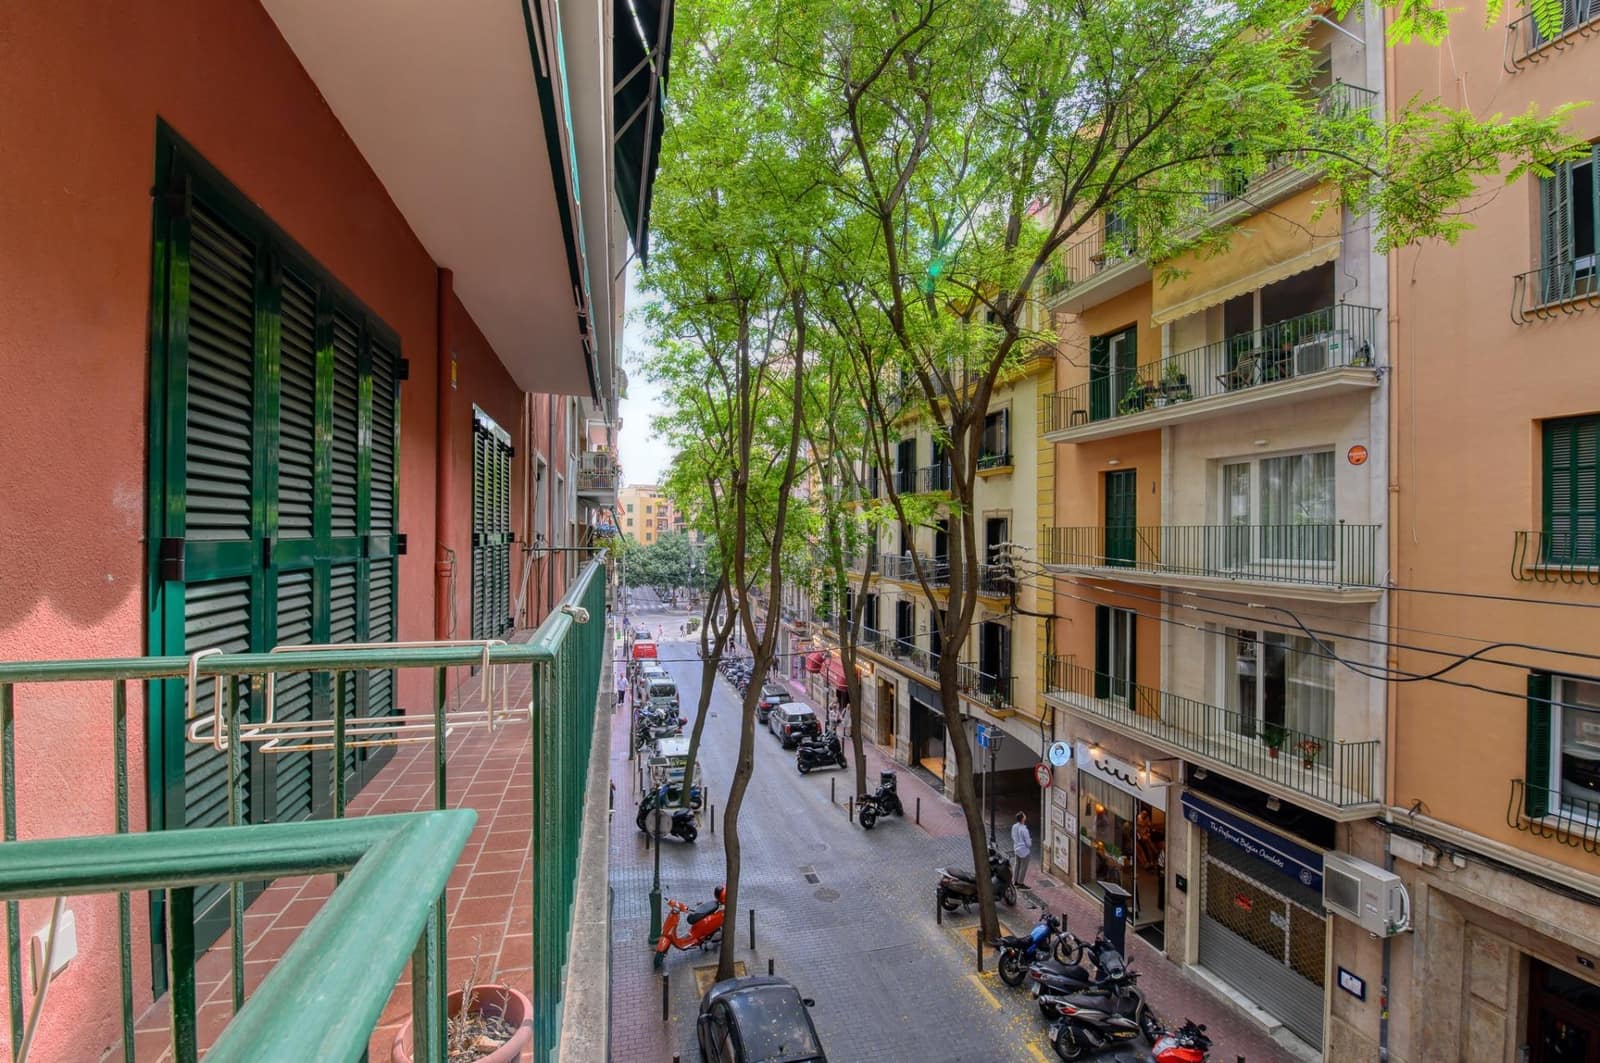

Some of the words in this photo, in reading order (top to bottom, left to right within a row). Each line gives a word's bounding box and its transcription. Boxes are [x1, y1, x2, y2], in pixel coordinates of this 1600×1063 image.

[1209, 821, 1218, 832] The
[1240, 837, 1258, 853] Belgian
[1115, 906, 1123, 918] P
